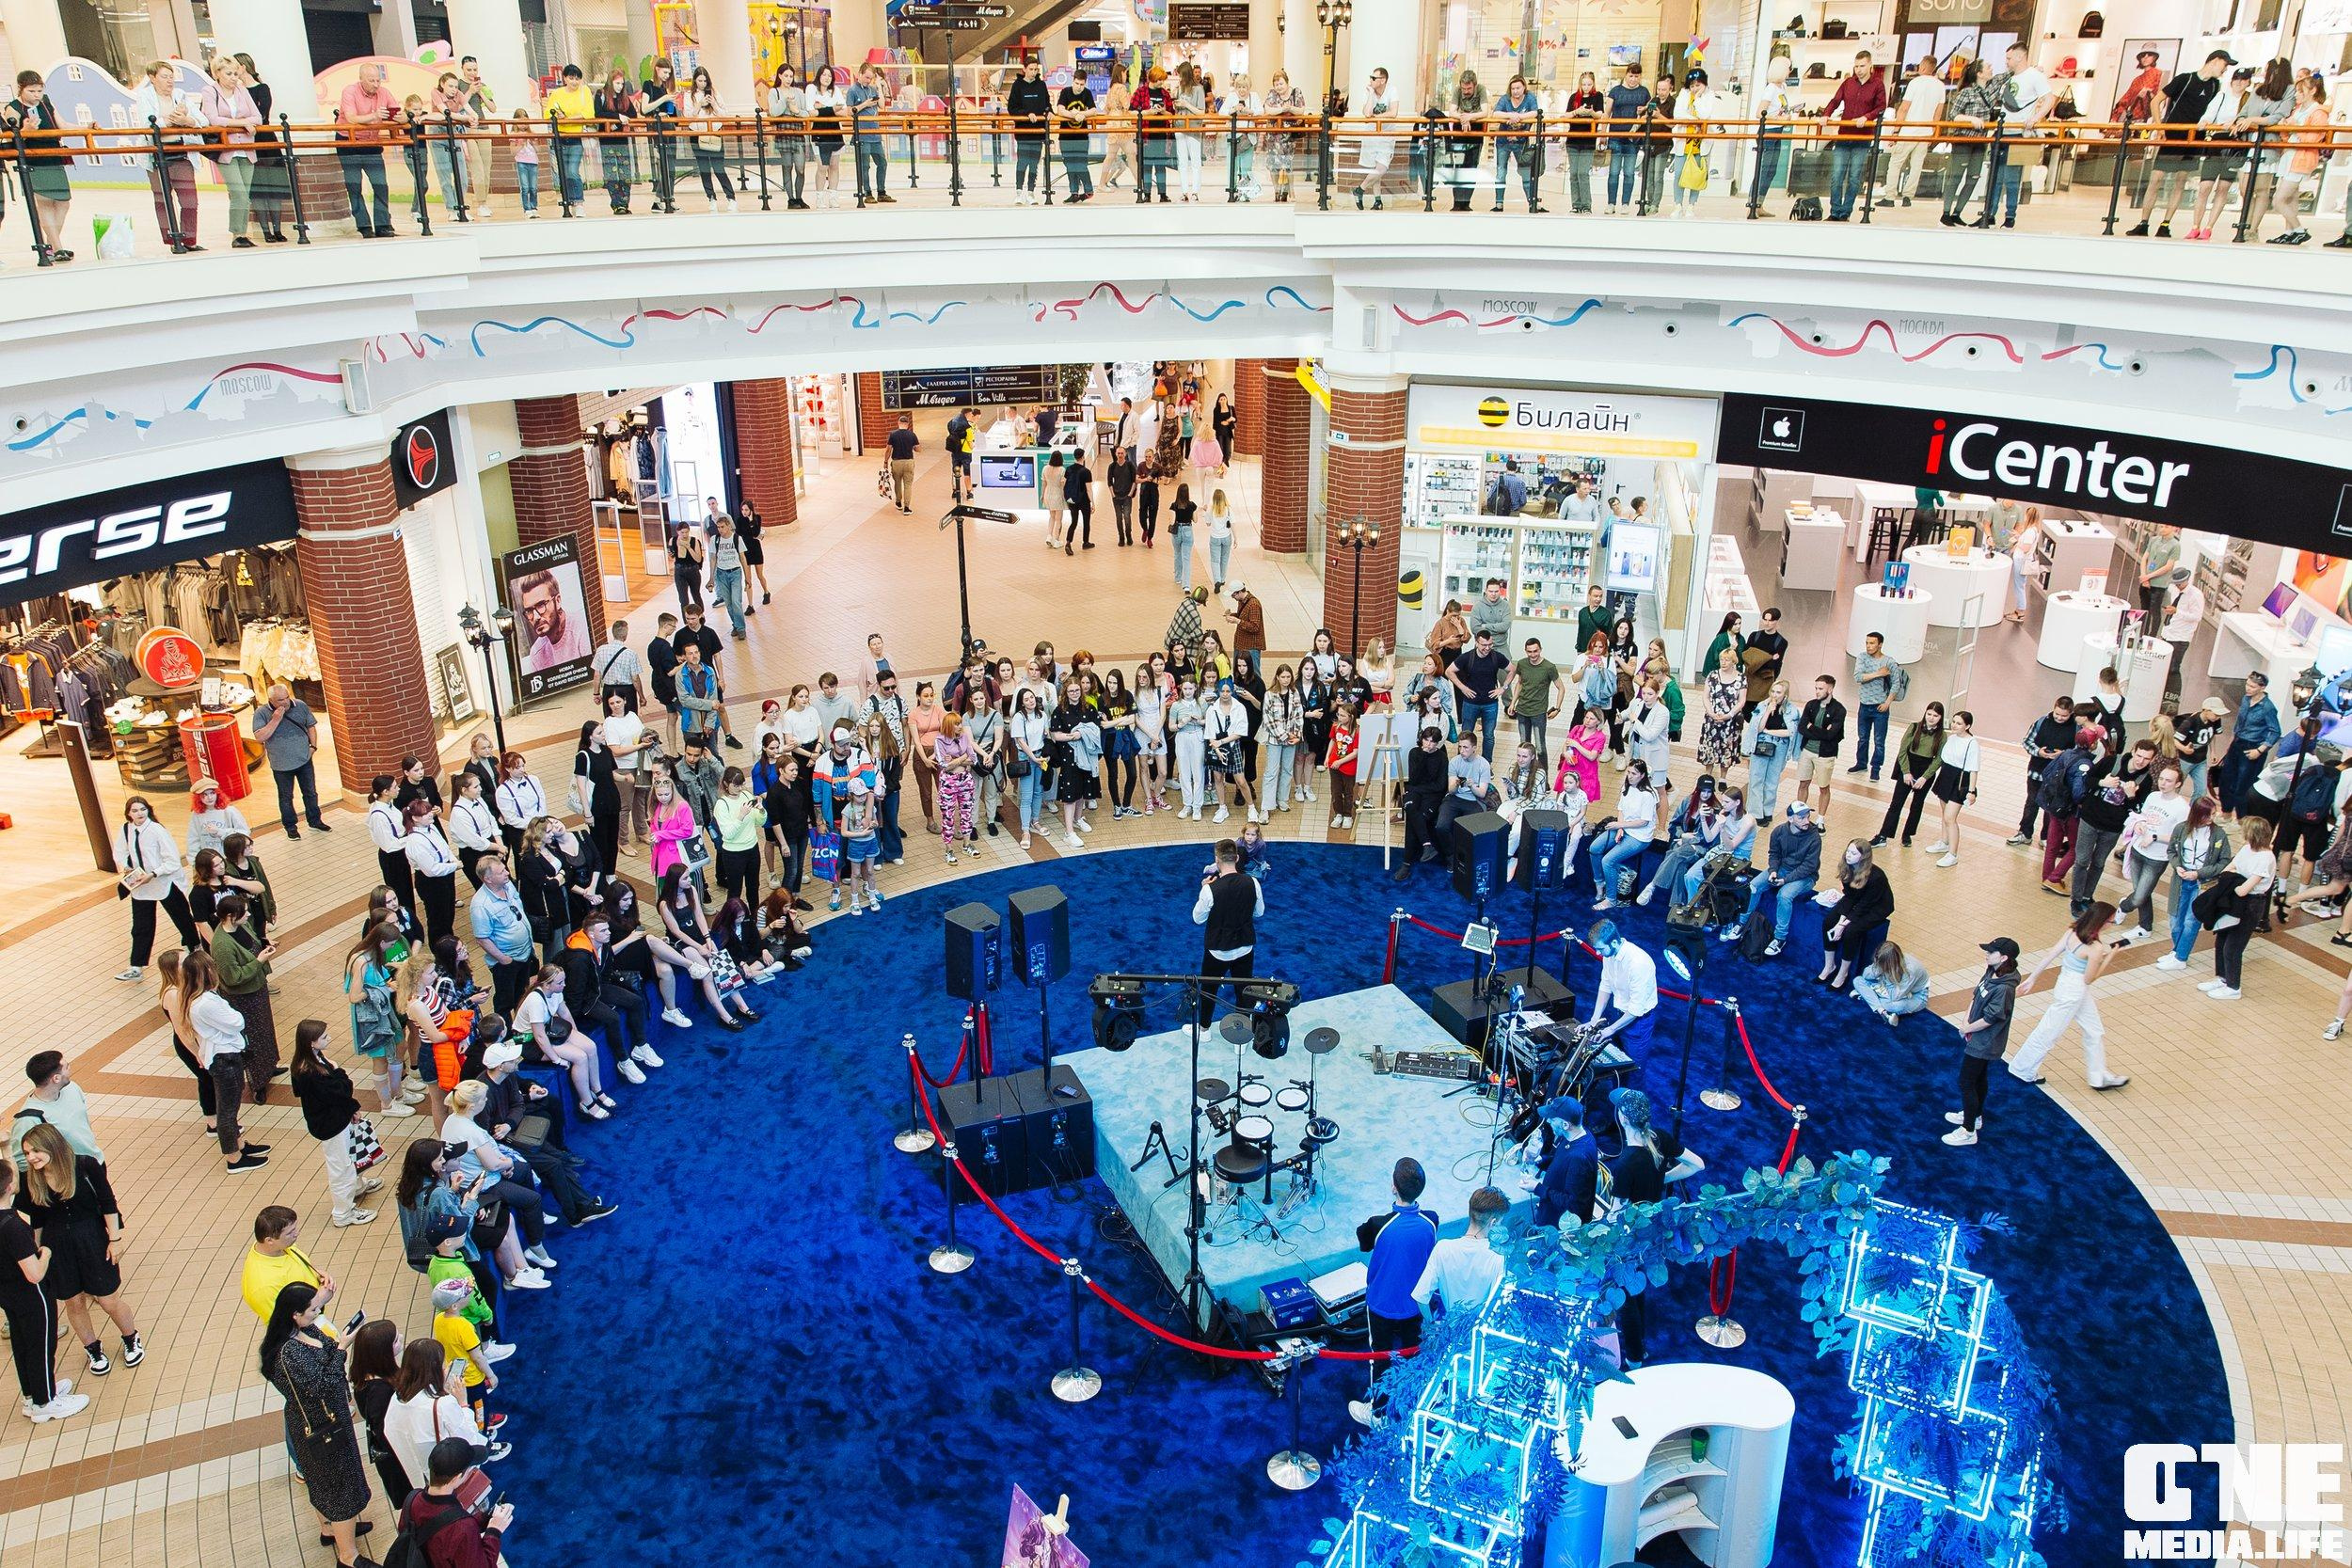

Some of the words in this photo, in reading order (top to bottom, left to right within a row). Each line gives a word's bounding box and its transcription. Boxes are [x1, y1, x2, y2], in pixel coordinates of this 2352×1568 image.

[1483, 299, 1538, 314] MOSCOW
[1899, 319, 1944, 335] МОСКВА
[220, 374, 272, 396] MOSCOW
[1517, 402, 1629, 432] Билайн
[1926, 419, 2190, 508] iCenter
[514, 541, 568, 565] GLASSMAN
[812, 847, 839, 859] ZCN
